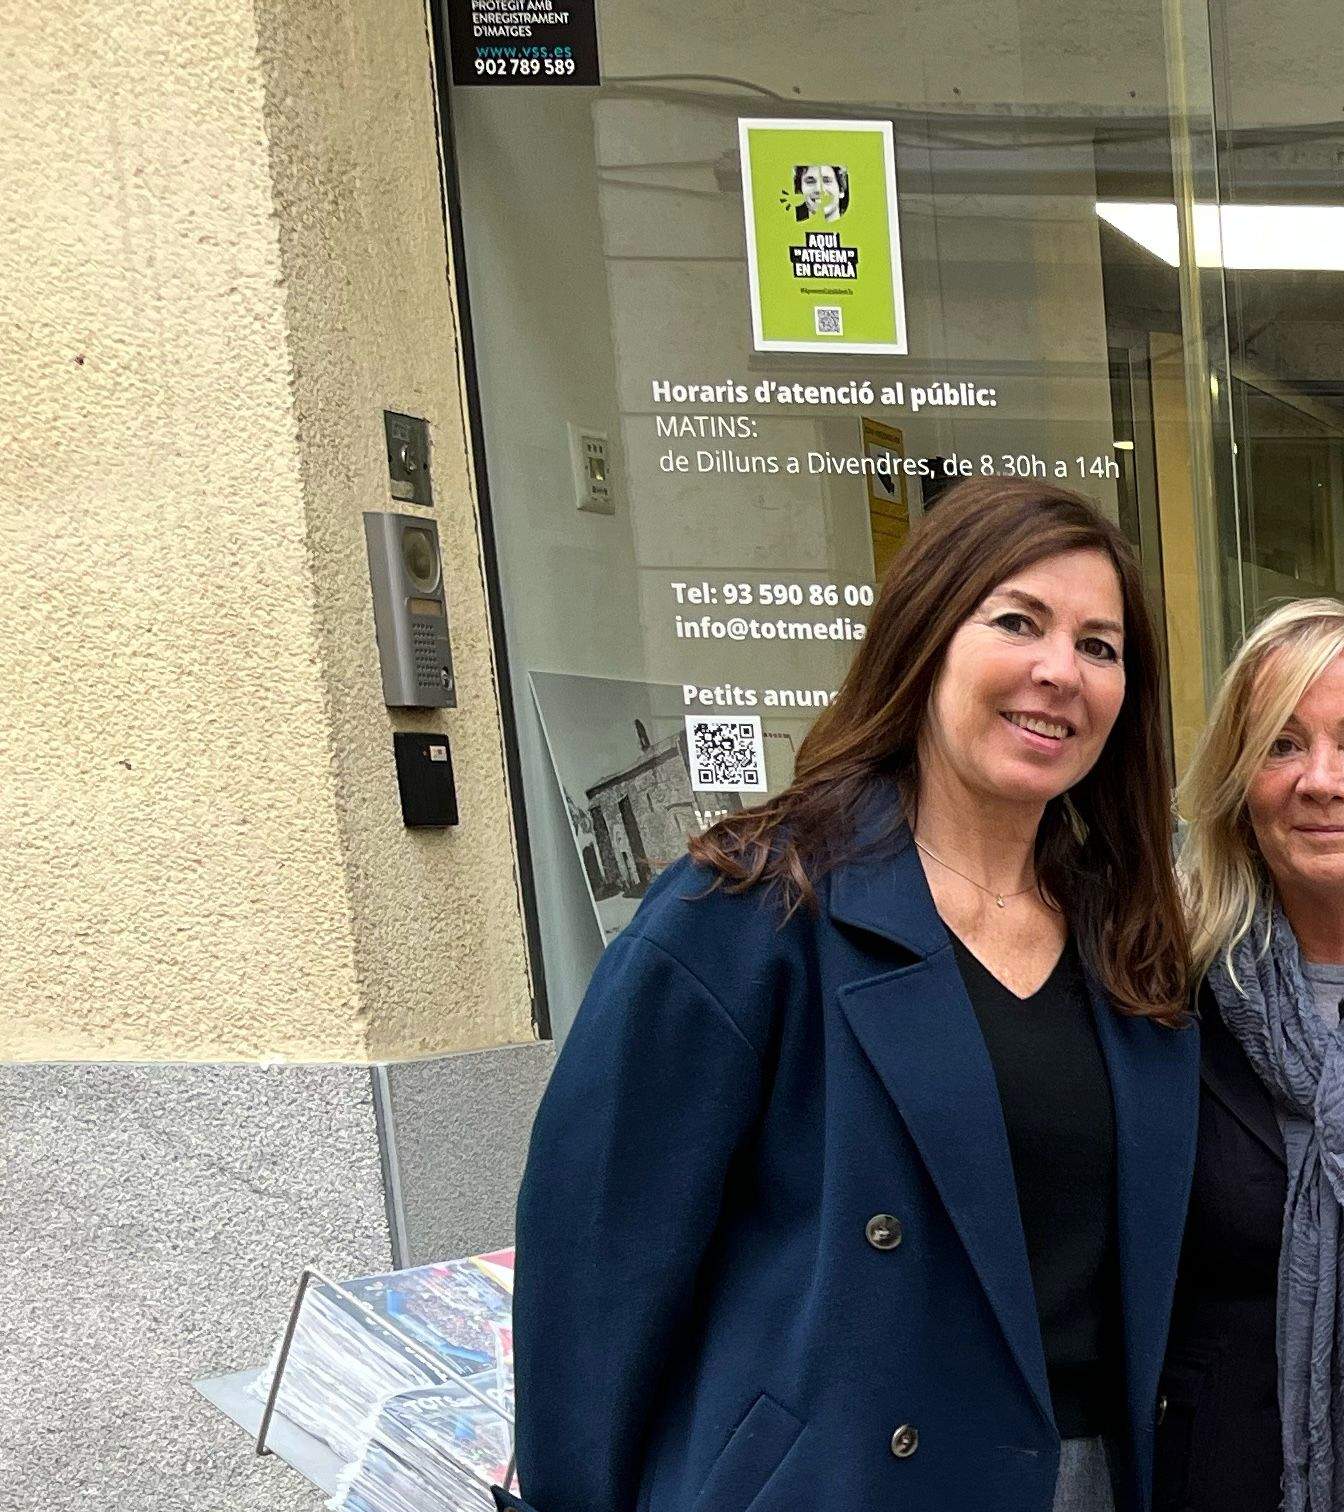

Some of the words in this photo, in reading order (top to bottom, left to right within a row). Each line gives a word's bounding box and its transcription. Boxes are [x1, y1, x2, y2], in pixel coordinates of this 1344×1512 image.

[471, 0, 526, 11] PROTEGIT
[527, 0, 553, 11] AMB
[472, 12, 569, 24] ENREGISTRAMENT
[473, 25, 533, 37] D'IMATGES
[475, 46, 573, 58] www.vss.es
[474, 58, 507, 75] 902
[510, 58, 541, 75] 789
[544, 59, 576, 75] 589
[808, 232, 838, 249] AQUÍ
[795, 263, 812, 277] EN
[813, 262, 856, 278] CATALÀ
[652, 379, 749, 403] Horaris
[754, 380, 875, 404] d'atenció
[880, 382, 904, 405] al
[910, 382, 997, 412] públic:
[655, 415, 758, 438] MATINS:
[659, 450, 690, 473] de
[696, 450, 780, 473] Dilluns
[786, 458, 800, 474] a
[807, 451, 936, 479] Divendres,
[943, 453, 973, 477] de
[980, 453, 1047, 477] 8.30h
[1054, 461, 1068, 478] a
[1075, 455, 1120, 479] 14h
[671, 582, 718, 605] Tel:
[722, 583, 753, 605] 93
[759, 584, 803, 606] 590
[809, 584, 839, 606] 86
[844, 585, 874, 607] 00
[675, 615, 867, 641] info@totmedia
[682, 684, 758, 706] Petits
